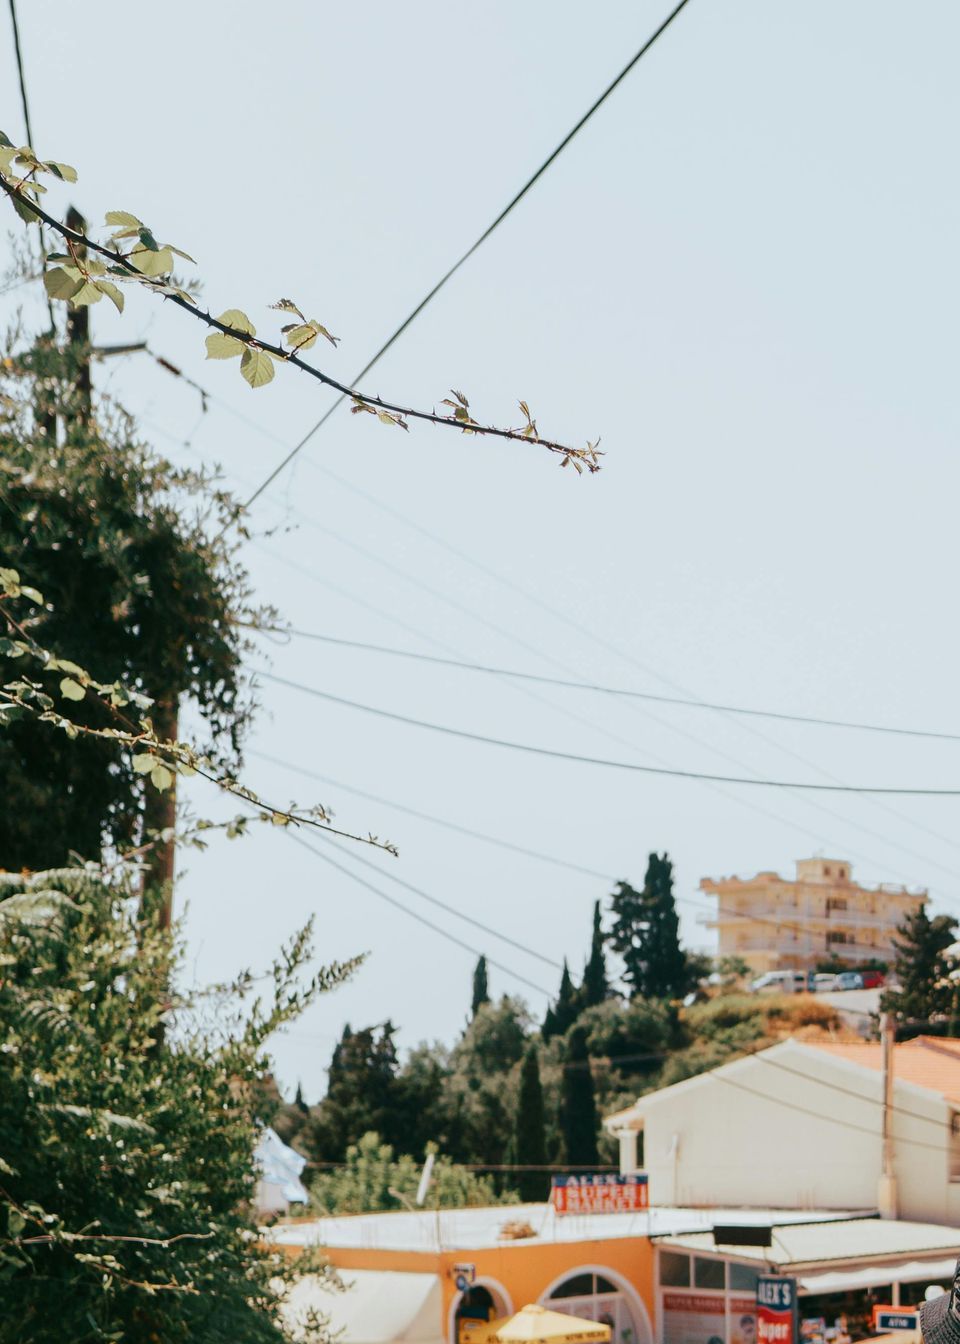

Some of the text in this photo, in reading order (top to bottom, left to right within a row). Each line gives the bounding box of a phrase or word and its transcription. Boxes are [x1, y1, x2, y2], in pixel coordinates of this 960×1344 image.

[566, 1174, 637, 1187] ALEX'S
[566, 1186, 635, 1199] SUPER
[758, 1282, 792, 1306] ALEX'S
[758, 1317, 789, 1342] Super
